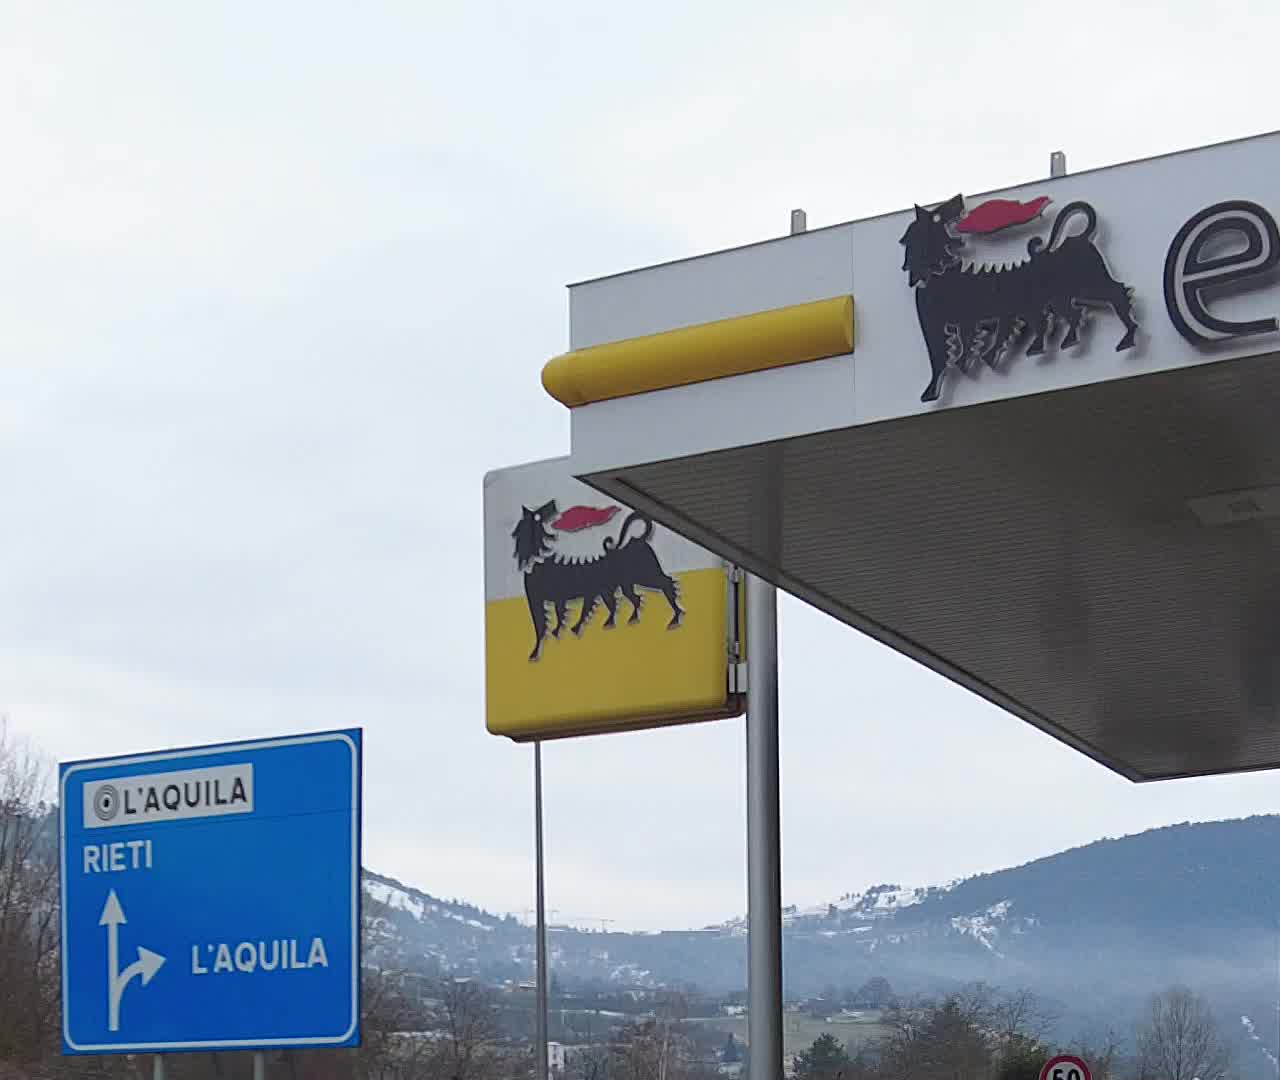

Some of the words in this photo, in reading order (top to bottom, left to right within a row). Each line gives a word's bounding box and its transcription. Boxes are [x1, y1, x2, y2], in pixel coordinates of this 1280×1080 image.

[124, 777, 248, 814] L'AQUILA
[83, 840, 153, 873] RIETI
[192, 937, 329, 975] L'AQUILA
